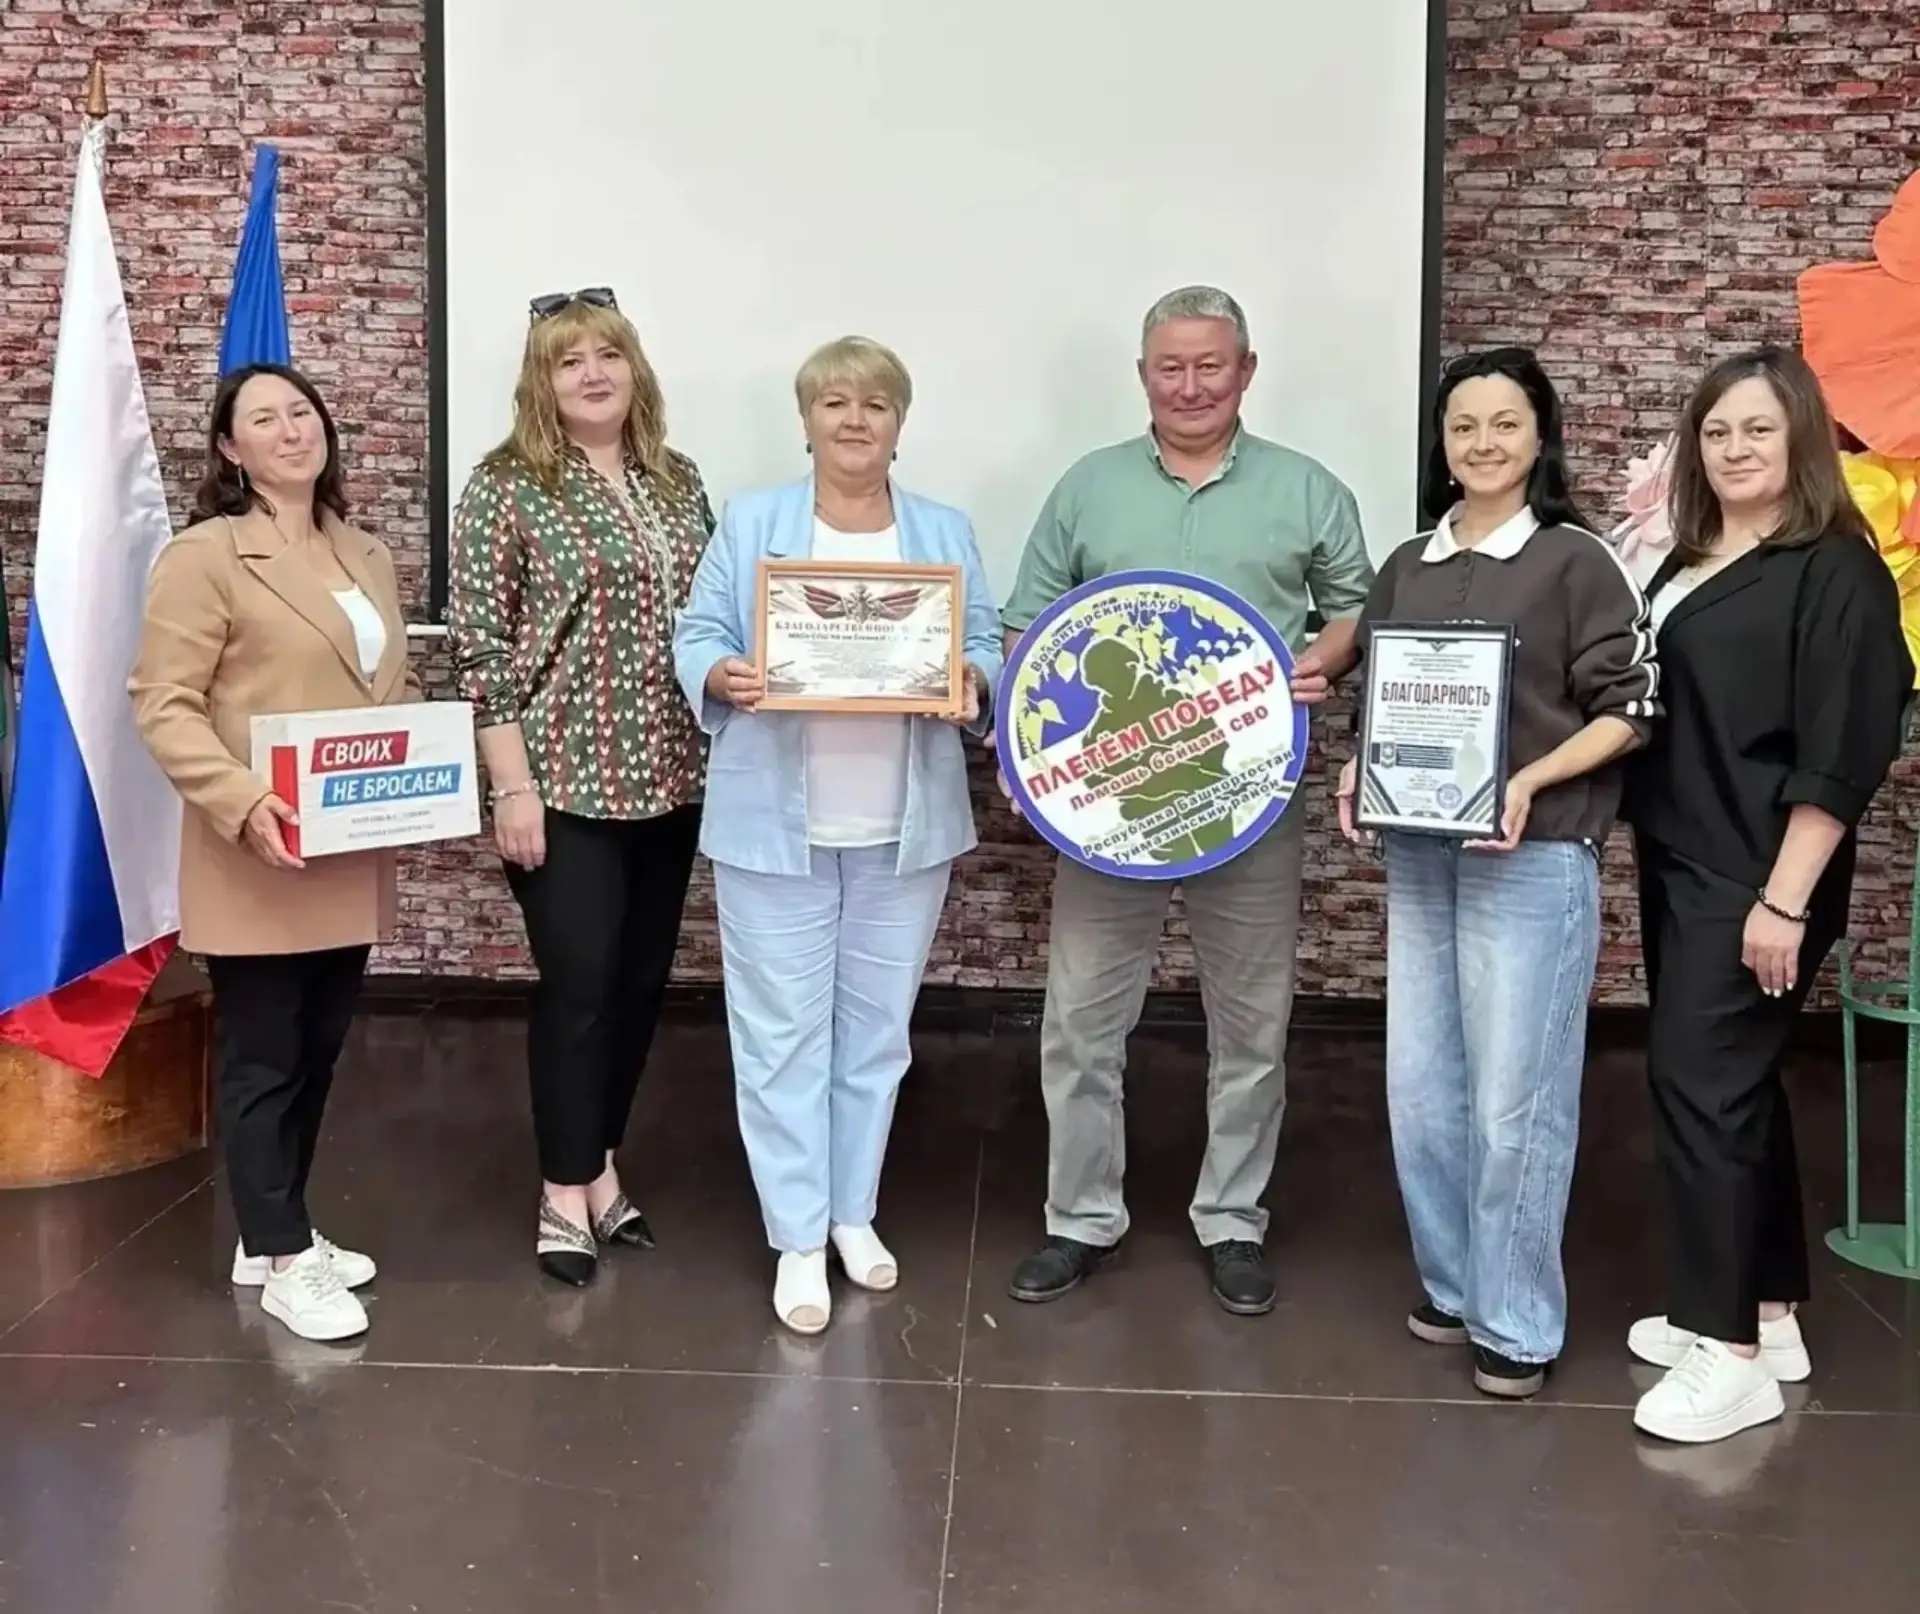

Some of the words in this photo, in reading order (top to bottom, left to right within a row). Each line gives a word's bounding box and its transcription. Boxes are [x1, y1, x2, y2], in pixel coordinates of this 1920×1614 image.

[1139, 597, 1178, 611] клуб
[1381, 682, 1491, 706] БЛАГОДАРНОСТЬ
[321, 738, 393, 767] СВОИХ
[1027, 725, 1148, 798] ПЛЕТЁМ
[1152, 661, 1275, 738] ПОБЕДУ
[332, 780, 359, 802] НЕ
[363, 770, 452, 799] БРОСАЕМ
[1070, 766, 1149, 811] Помощь
[1153, 729, 1226, 769] бойцам
[1083, 808, 1175, 857] Республика
[1177, 750, 1294, 813] Башкортостан
[1112, 805, 1226, 865] Туймазинский
[1228, 779, 1279, 813] район
